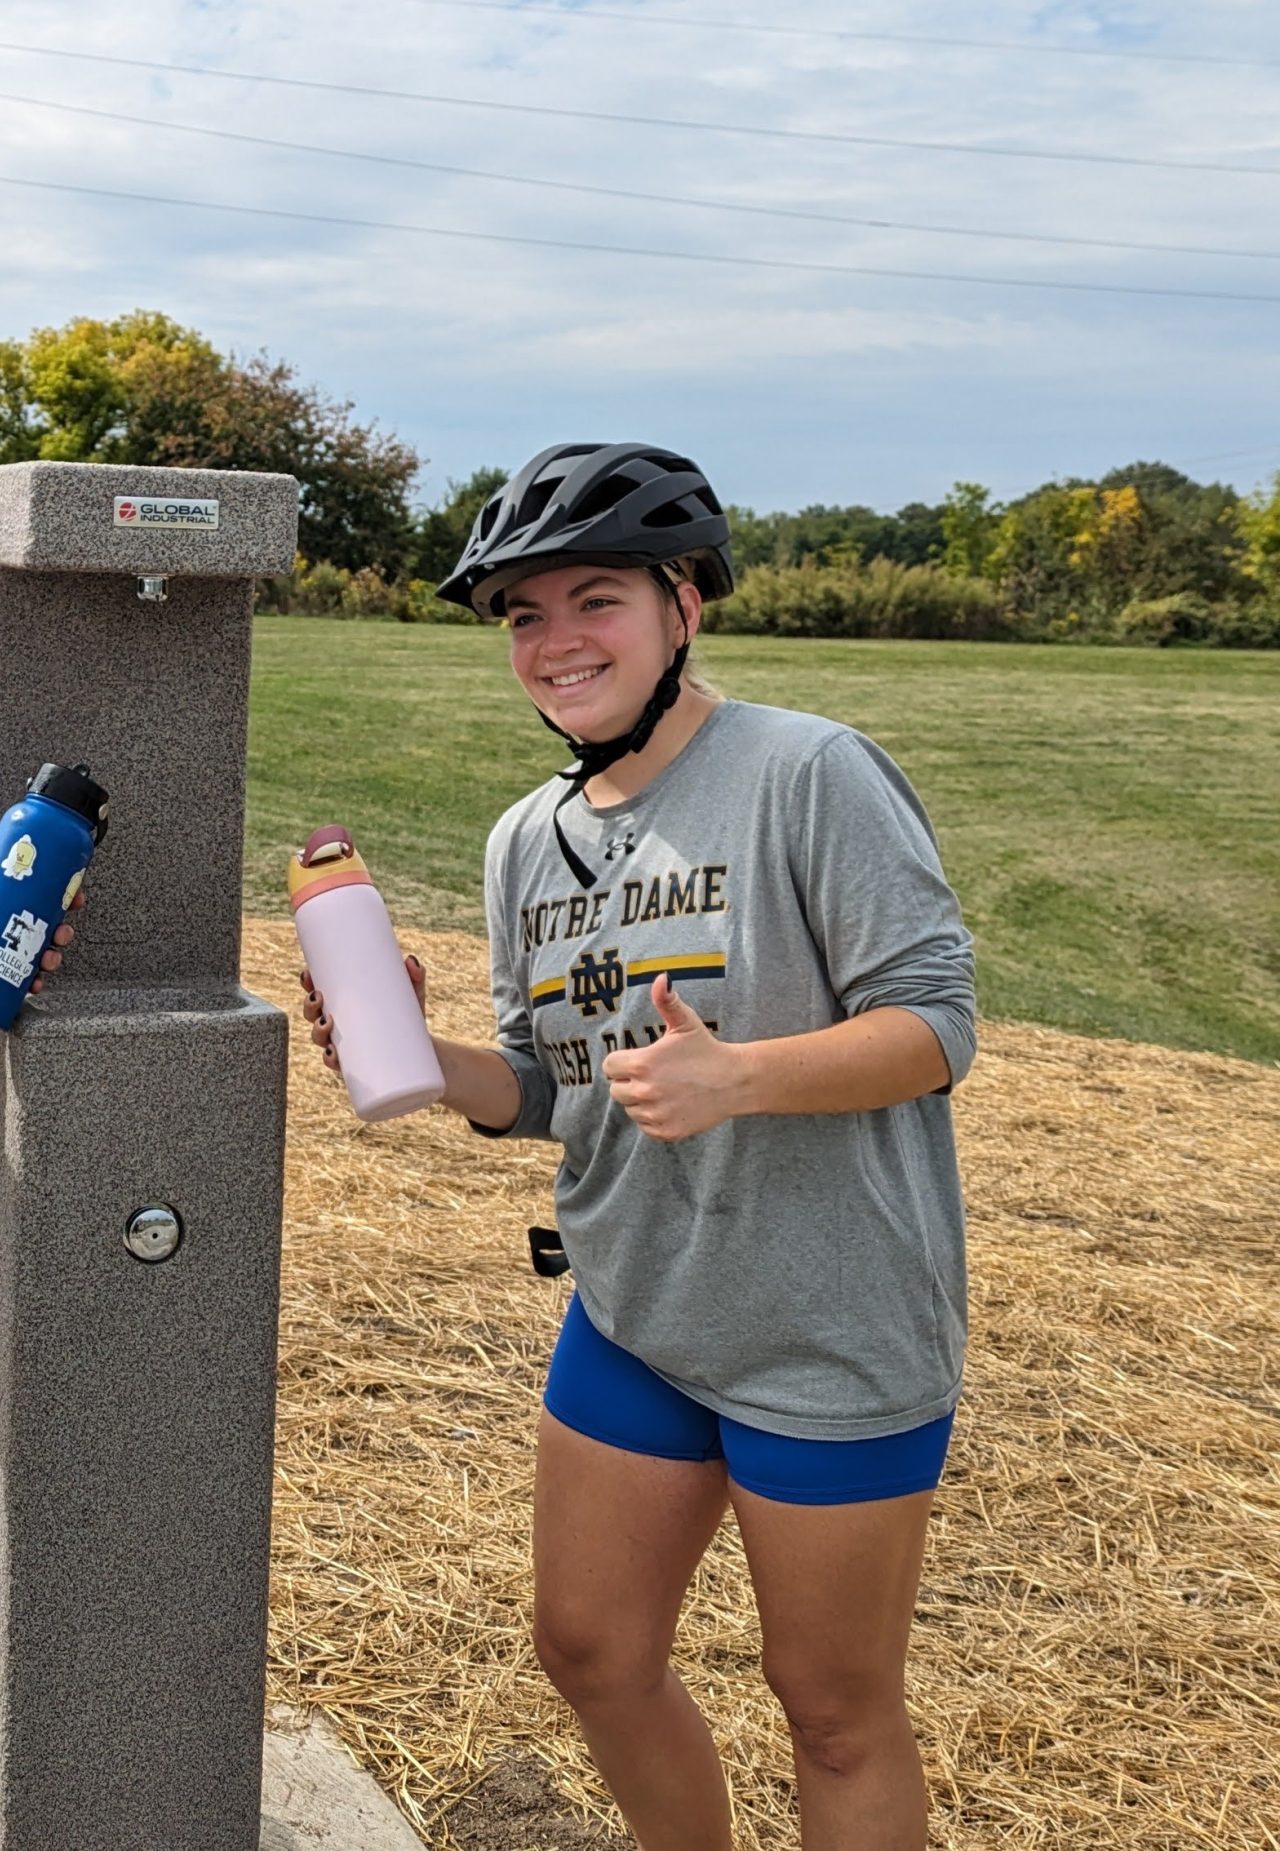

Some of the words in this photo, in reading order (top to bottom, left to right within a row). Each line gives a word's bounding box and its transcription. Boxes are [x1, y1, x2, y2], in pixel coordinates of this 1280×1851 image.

[140, 503, 215, 516] GLOBAL
[140, 514, 215, 524] INDUSTRIAL
[521, 891, 611, 952] NOTRE
[620, 865, 728, 927] DAME
[543, 1038, 592, 1086] ISH
